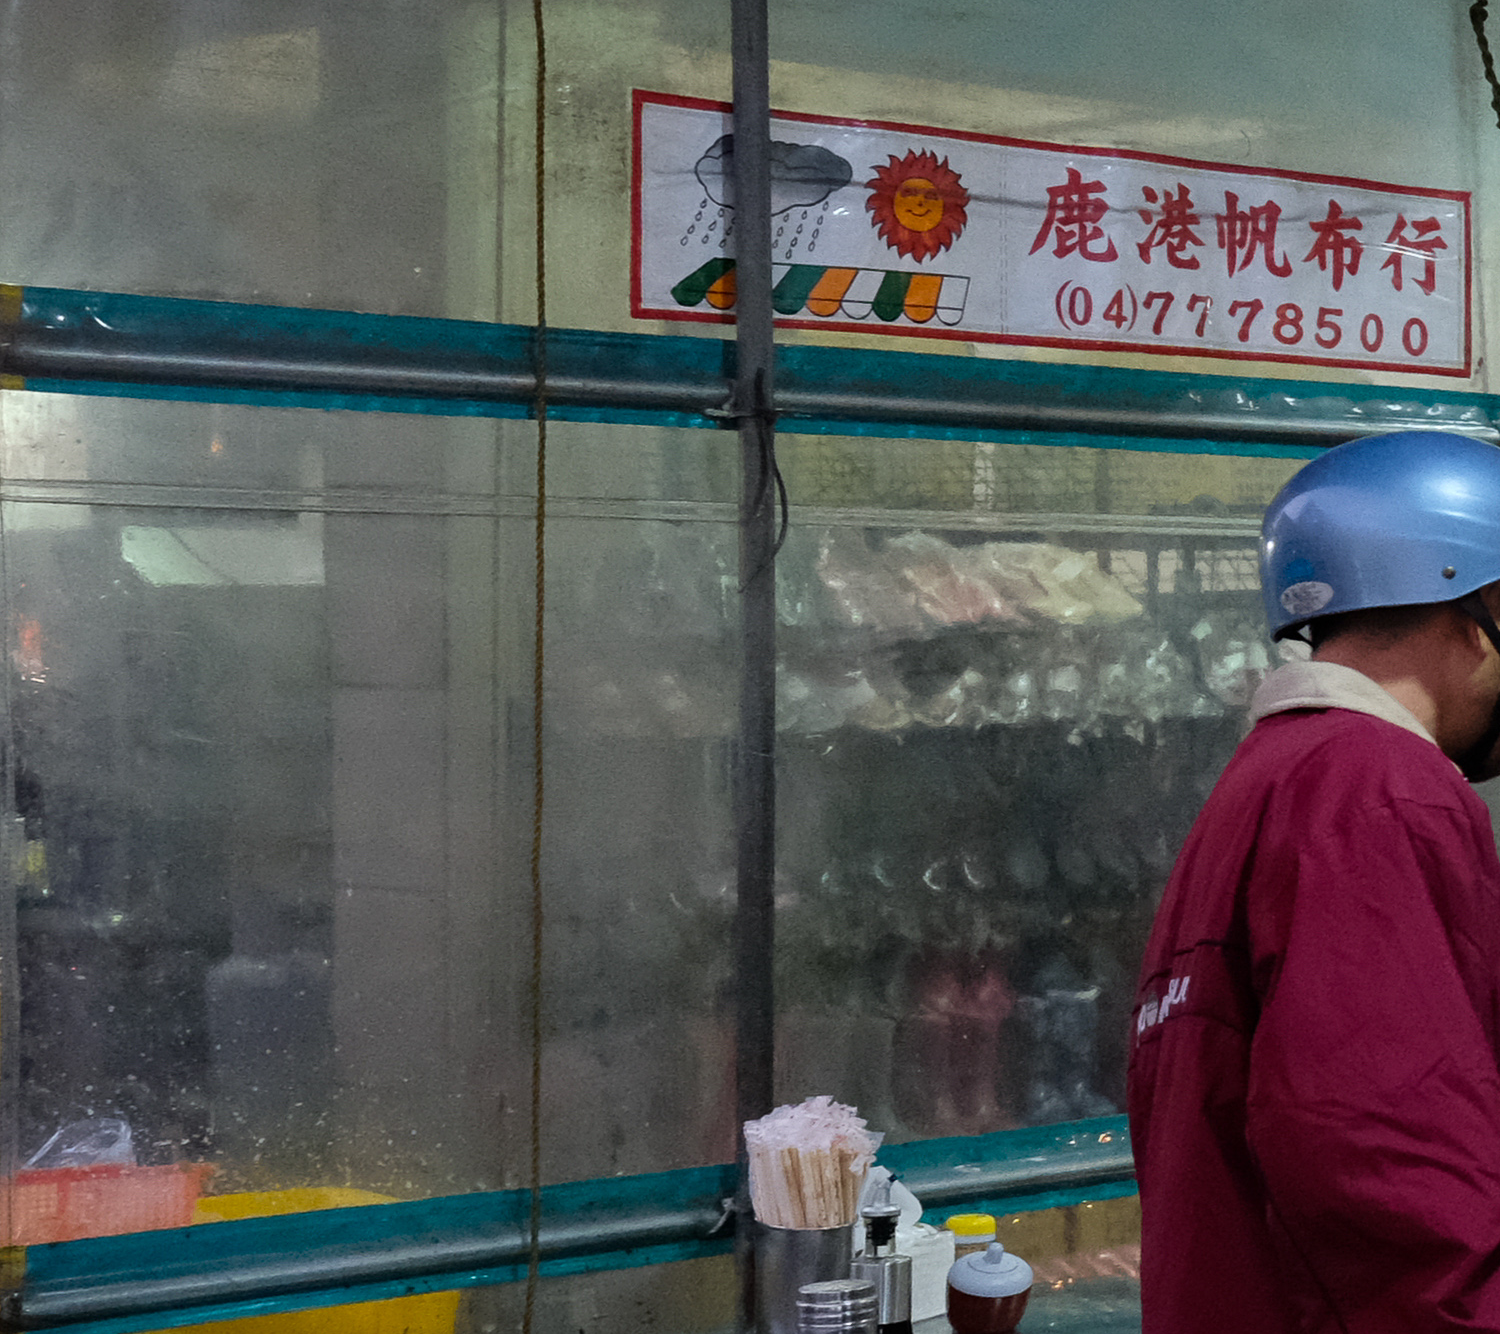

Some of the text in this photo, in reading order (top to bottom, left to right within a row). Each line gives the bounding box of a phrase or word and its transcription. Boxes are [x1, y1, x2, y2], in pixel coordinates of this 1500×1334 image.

[1029, 167, 1447, 297] 鹿港帆布行
[1055, 279, 1429, 358] (04)7778500
